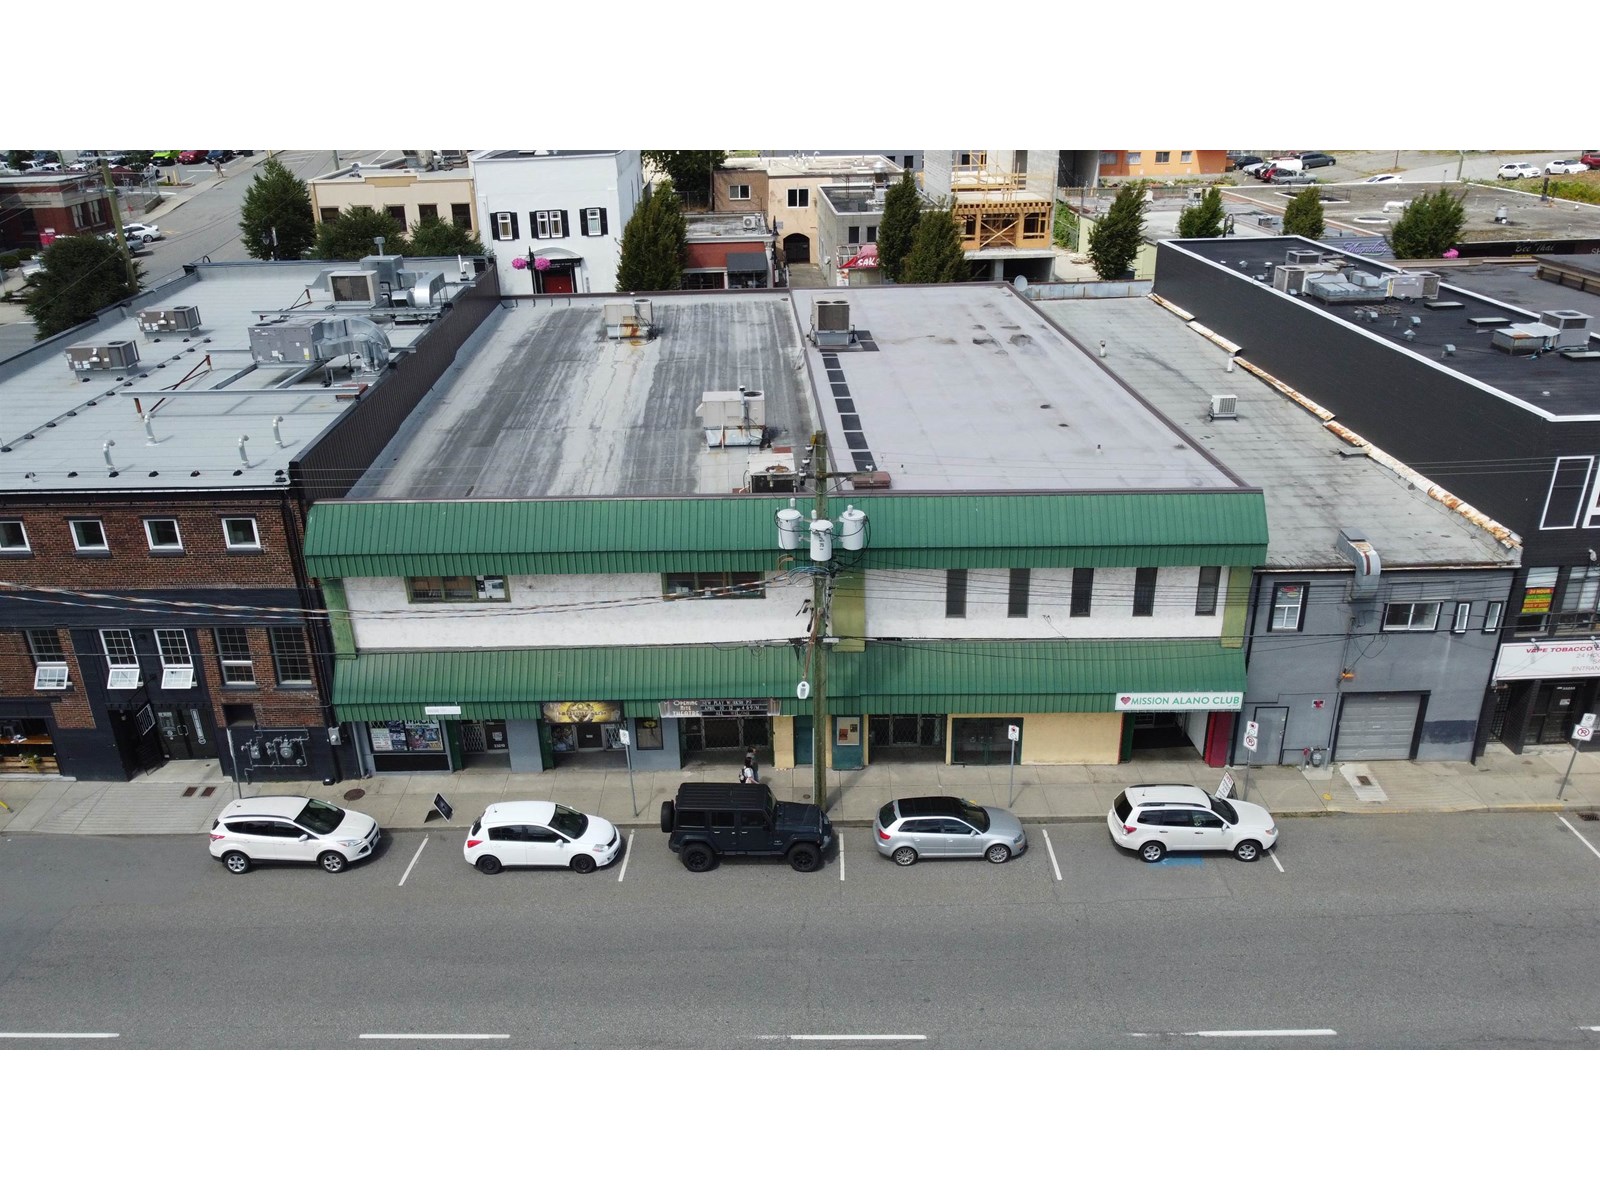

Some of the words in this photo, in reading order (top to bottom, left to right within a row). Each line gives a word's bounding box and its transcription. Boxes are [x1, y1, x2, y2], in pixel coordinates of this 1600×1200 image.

[1526, 646, 1548, 654] VAPE
[1131, 696, 1170, 705] MISSION
[1172, 696, 1210, 705] ALANO
[1212, 696, 1240, 705] CLUB
